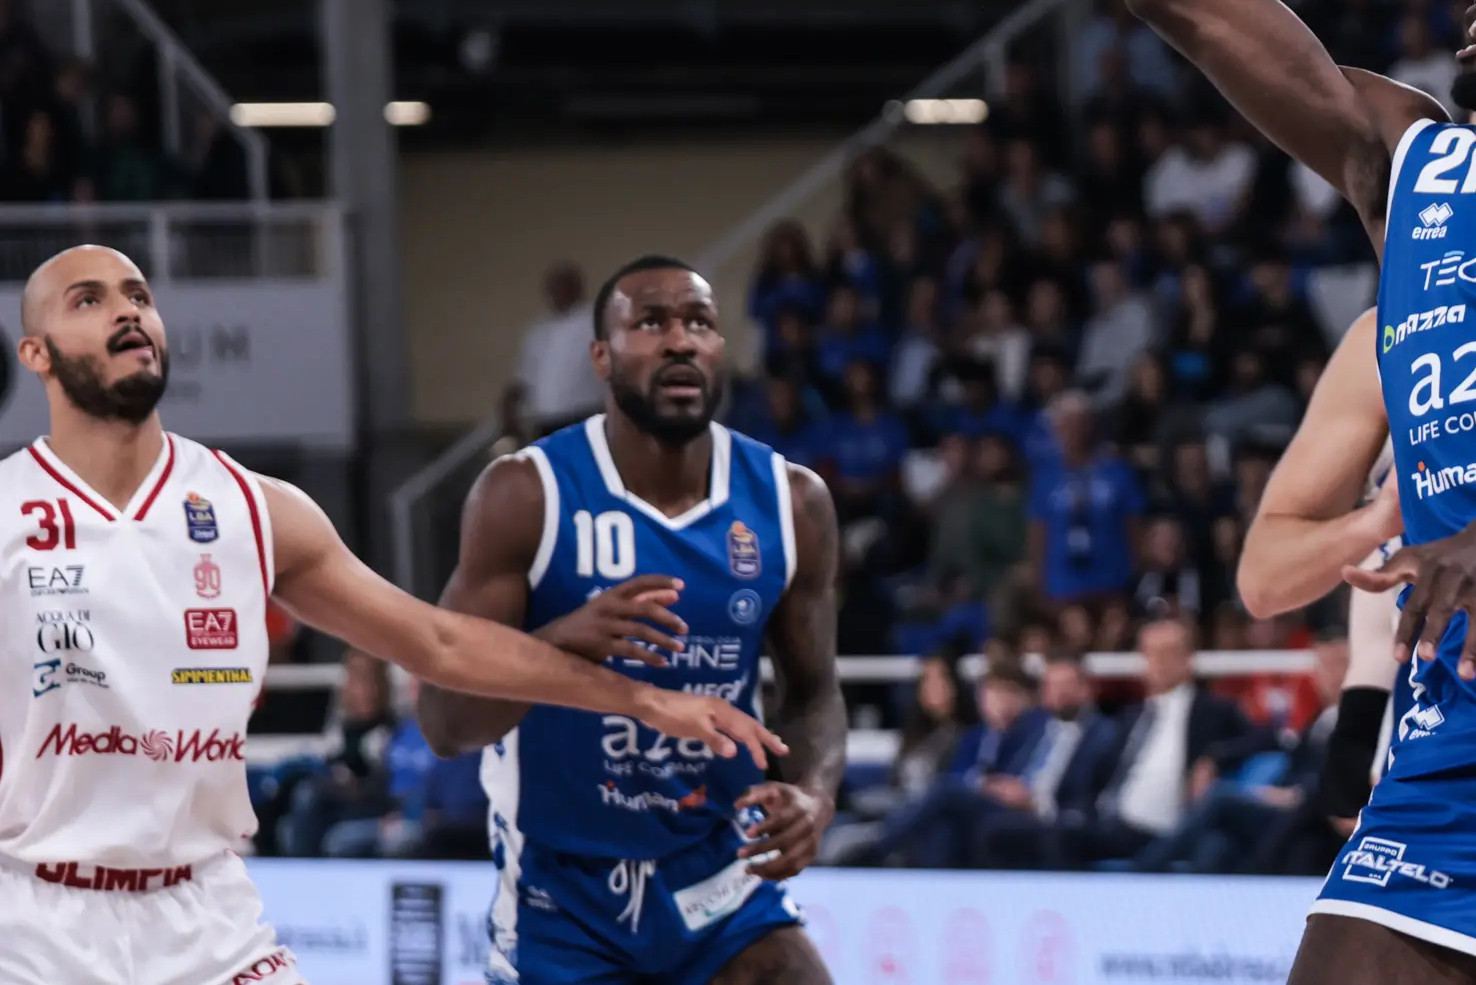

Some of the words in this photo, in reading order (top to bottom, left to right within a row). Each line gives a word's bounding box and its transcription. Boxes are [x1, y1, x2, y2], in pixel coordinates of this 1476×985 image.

[1410, 423, 1440, 446] LIFE
[20, 497, 76, 551] 31
[574, 510, 636, 579] 10
[28, 565, 85, 589] EA7
[187, 612, 233, 632] EA7
[65, 662, 107, 682] Group
[1364, 843, 1397, 856] GRUPPO
